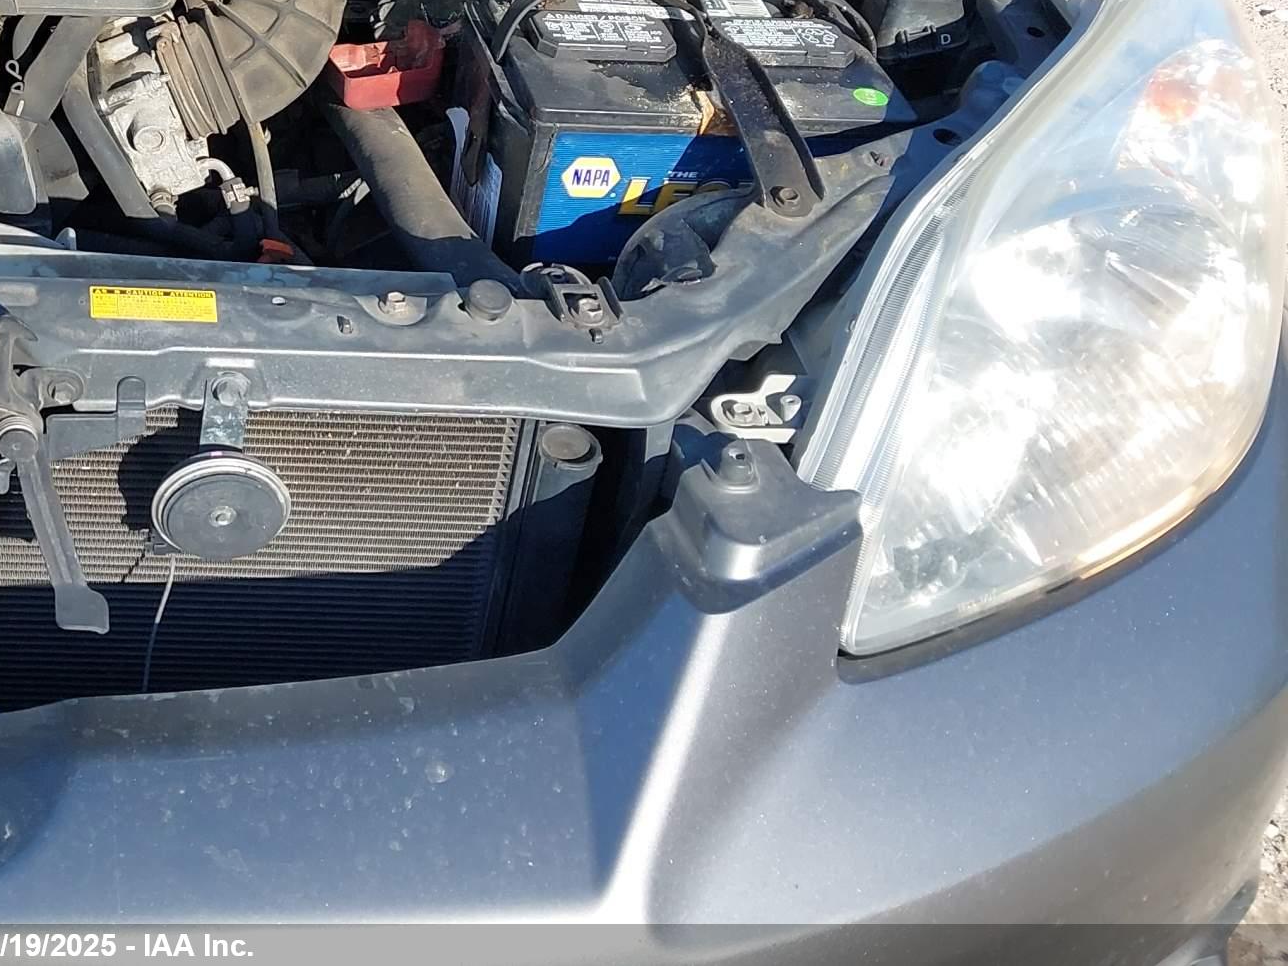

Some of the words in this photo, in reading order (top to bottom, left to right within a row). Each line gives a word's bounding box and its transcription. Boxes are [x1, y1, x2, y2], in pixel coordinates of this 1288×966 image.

[553, 13, 599, 21] DANGER
[607, 14, 647, 22] POISON
[571, 168, 611, 187] NAPA
[667, 171, 699, 179] THE
[125, 289, 164, 297] CAUTION
[169, 291, 212, 299] ATTENTION
